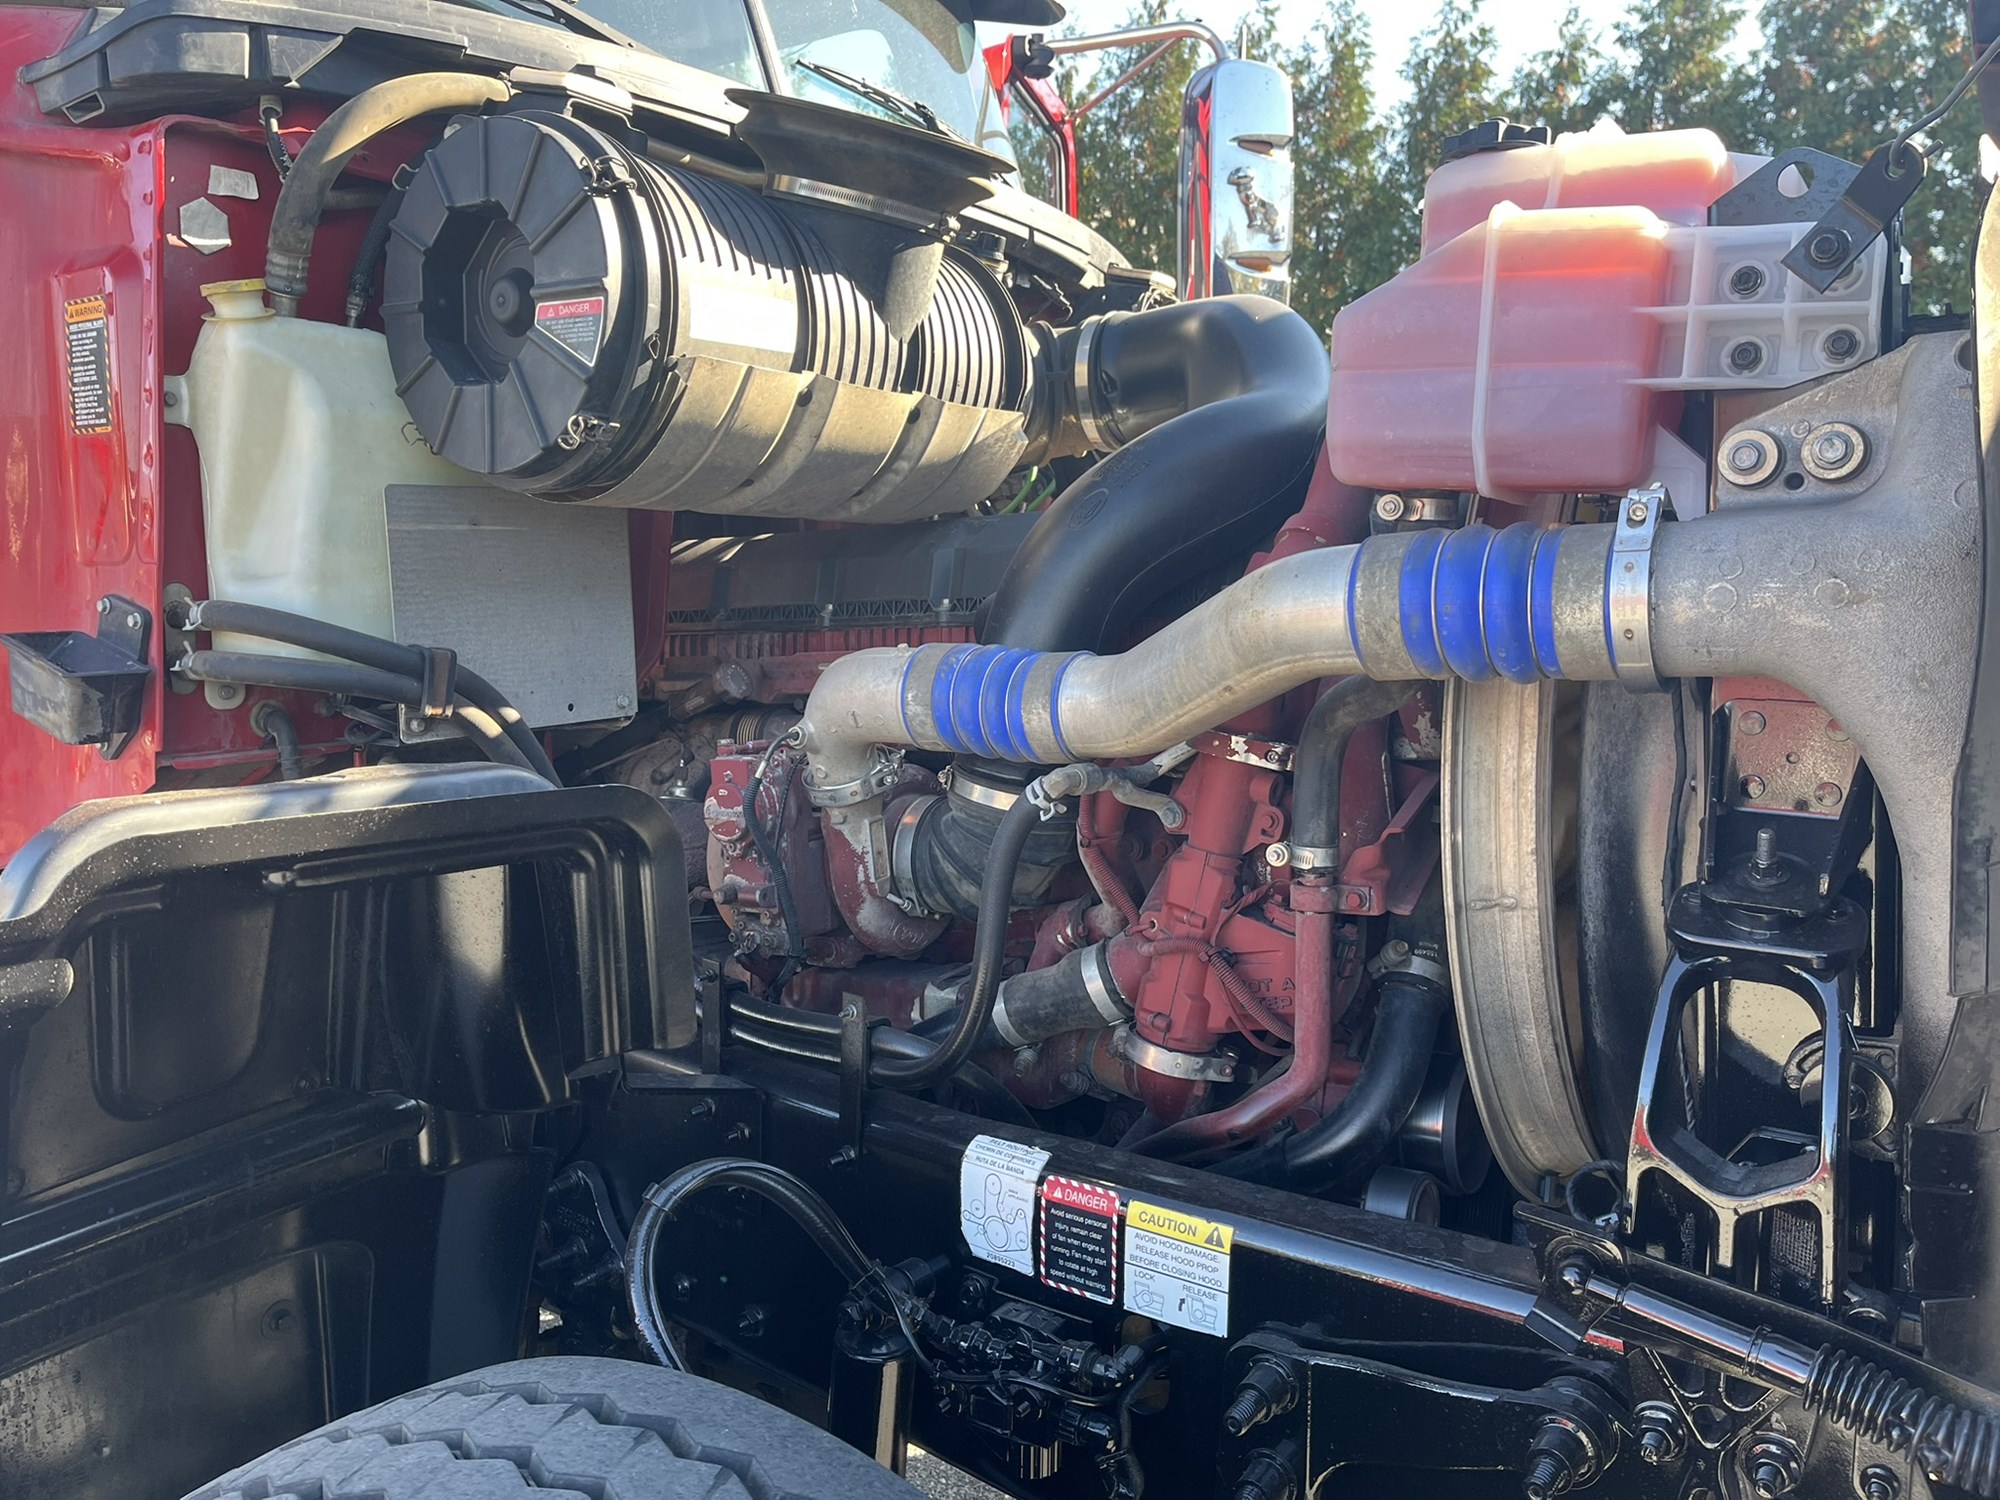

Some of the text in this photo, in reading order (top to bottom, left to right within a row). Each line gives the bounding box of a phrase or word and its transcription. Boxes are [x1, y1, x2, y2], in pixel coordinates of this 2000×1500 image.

[74, 304, 102, 317] WARNING
[559, 303, 590, 315] DANGER
[1240, 977, 1296, 992] OT A
[1254, 996, 1292, 1010] TEP
[975, 1144, 996, 1154] CHEMIN
[975, 1156, 988, 1166] RUTA
[1006, 1165, 1025, 1176] BANDA
[1065, 1189, 1108, 1211] DANGER
[1051, 1207, 1108, 1229] Avoid serious personal
[1139, 1211, 1197, 1237] CAUTION
[1071, 1227, 1088, 1236] remain
[1089, 1232, 1102, 1240] clear
[1058, 1234, 1066, 1242] fan
[1067, 1238, 1081, 1246] when
[1082, 1242, 1099, 1252] engine
[1134, 1233, 1158, 1244] AVOID
[1159, 1240, 1183, 1252] HOOD
[1072, 1250, 1082, 1259] Fan
[1083, 1254, 1094, 1264] may
[1095, 1258, 1106, 1266] start
[1136, 1244, 1219, 1274] RELEASE HOOD PROP
[1050, 1268, 1065, 1278] speed
[1066, 1274, 1084, 1284] without
[1065, 1261, 1080, 1271] rotate
[1087, 1267, 1098, 1277] high
[1130, 1254, 1224, 1288] BEFORE CLOSING HOOD.
[1135, 1270, 1156, 1282] LOCK
[1183, 1285, 1218, 1301] RELEASE
